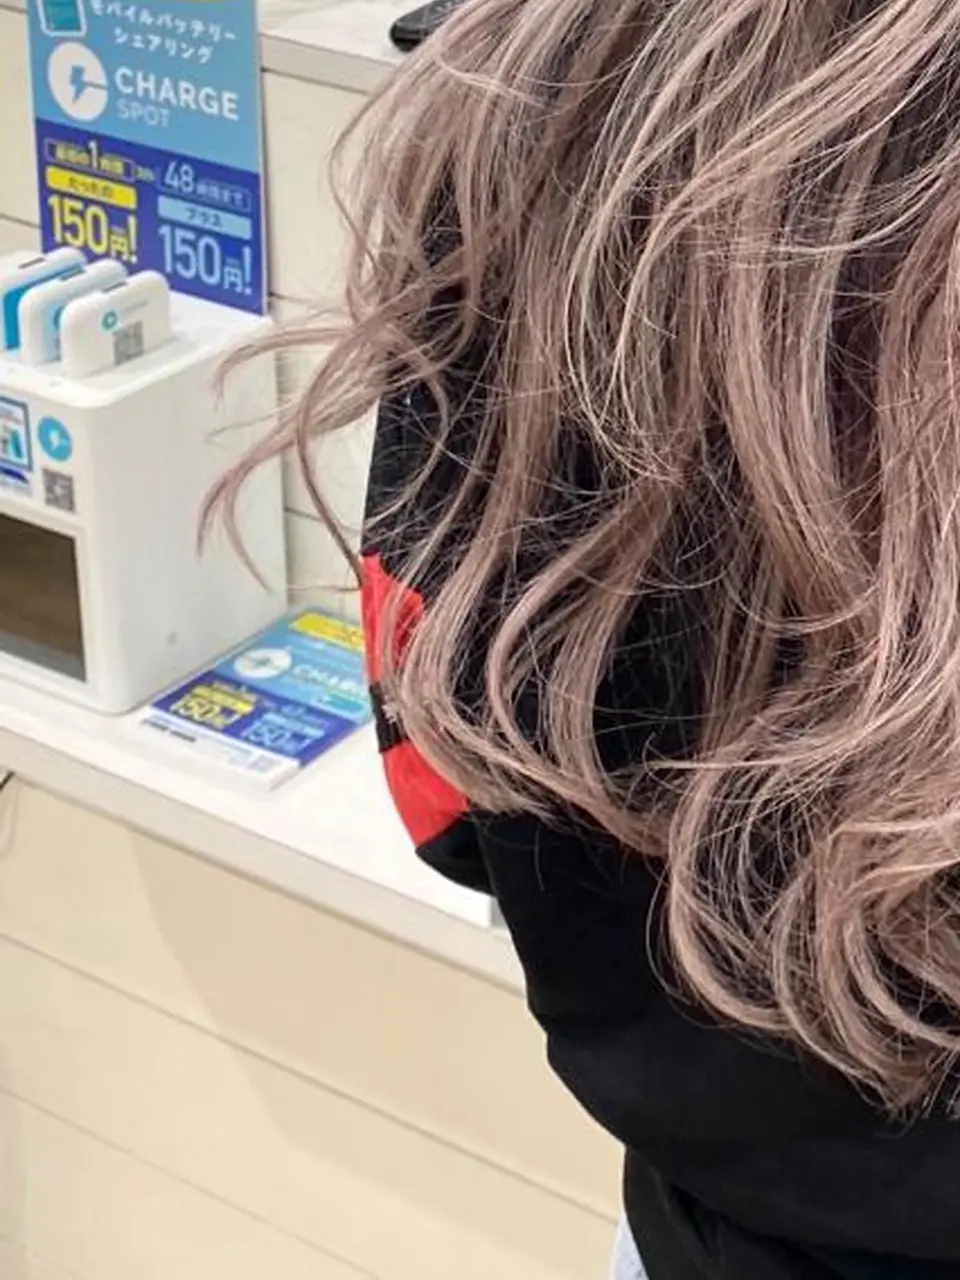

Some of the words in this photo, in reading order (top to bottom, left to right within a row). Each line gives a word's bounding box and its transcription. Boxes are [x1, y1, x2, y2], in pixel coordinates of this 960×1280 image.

[113, 26, 213, 64] シェアリング
[114, 66, 240, 121] CHARGE
[116, 96, 170, 127] SPOT
